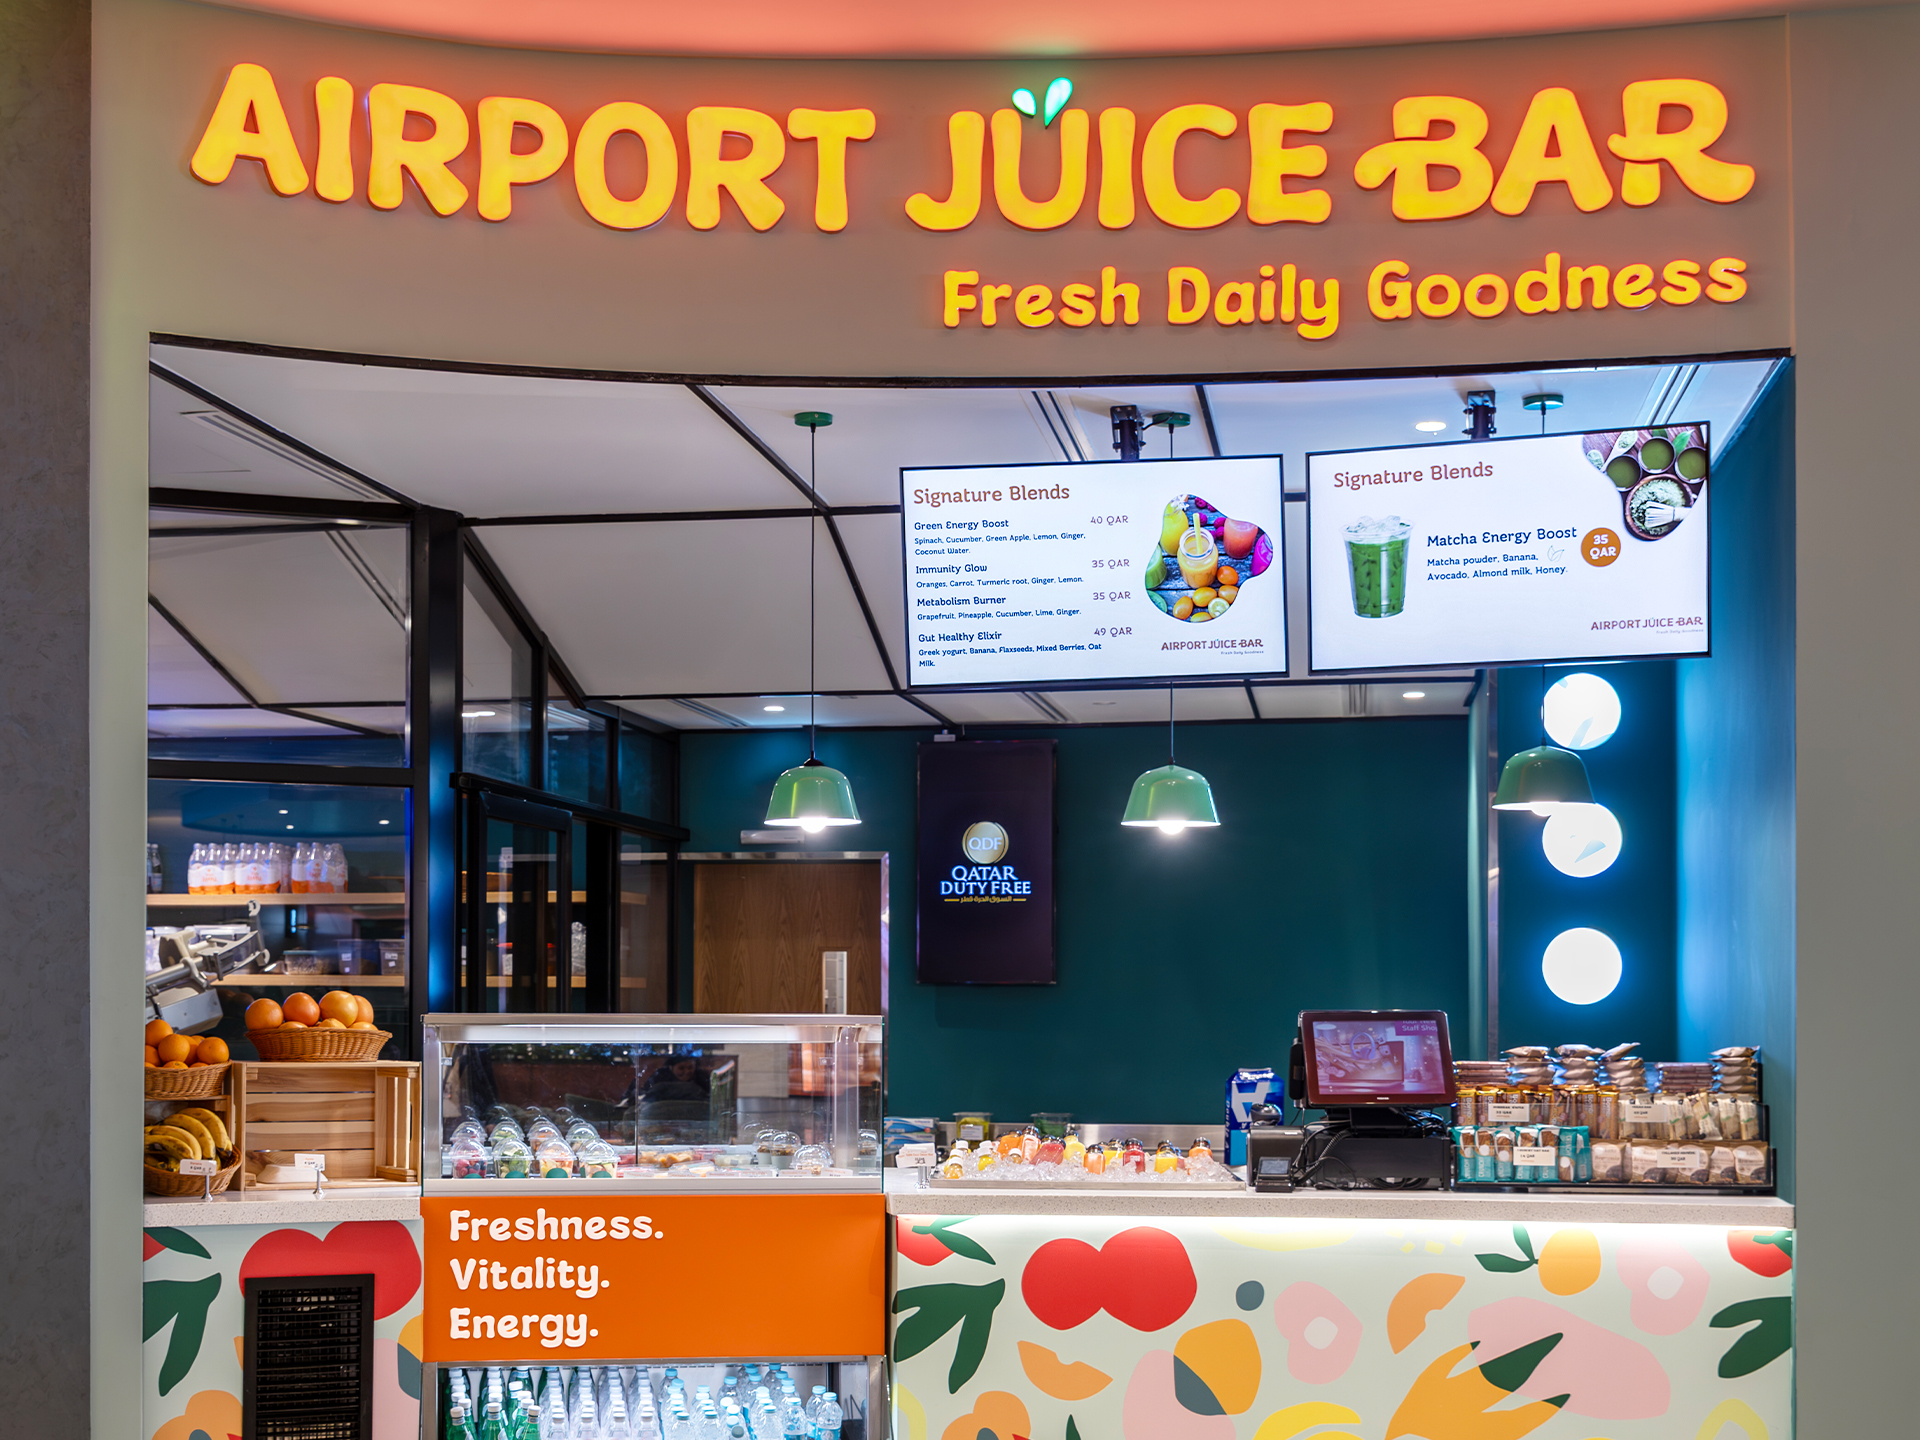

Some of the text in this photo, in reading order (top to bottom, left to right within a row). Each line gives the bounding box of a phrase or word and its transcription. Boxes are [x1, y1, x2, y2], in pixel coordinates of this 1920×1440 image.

[192, 64, 1754, 230] AIRPORT JUICE BAR
[944, 253, 1746, 338] Fresh Daily Goodness
[1333, 461, 1493, 491] Signature Blends
[913, 483, 1070, 508] Signature Blends
[914, 519, 1009, 530] Green Energy Boost
[1090, 514, 1128, 526] 40 QAR
[1426, 526, 1577, 547] Matcha Energy Boost
[1593, 534, 1608, 544] 35
[1589, 546, 1616, 560] QAR
[1091, 558, 1130, 569] 35 QAR
[1426, 557, 1460, 566] Matcha
[915, 563, 987, 575] Immunity Glow
[1472, 568, 1508, 578] Almond
[976, 578, 1010, 586] Turmeric
[916, 596, 1006, 607] Metabolism Burner
[1092, 590, 1131, 601] 35 QAR
[1590, 616, 1703, 630] AIRPORT JUICE BAR
[918, 630, 1002, 642] Gut Healthy Elixir
[1093, 626, 1132, 637] 49 QAR
[918, 648, 940, 656] Greek
[1036, 644, 1057, 652] Mixed
[1161, 638, 1264, 651] AIRPORT JUICE BAR
[968, 836, 1002, 851] QDF
[951, 865, 1019, 882] QATAR
[940, 881, 1032, 895] DUTY FREE
[450, 1208, 663, 1241] Freshness.
[450, 1257, 609, 1298] Vitality.
[450, 1308, 598, 1347] Energy.
